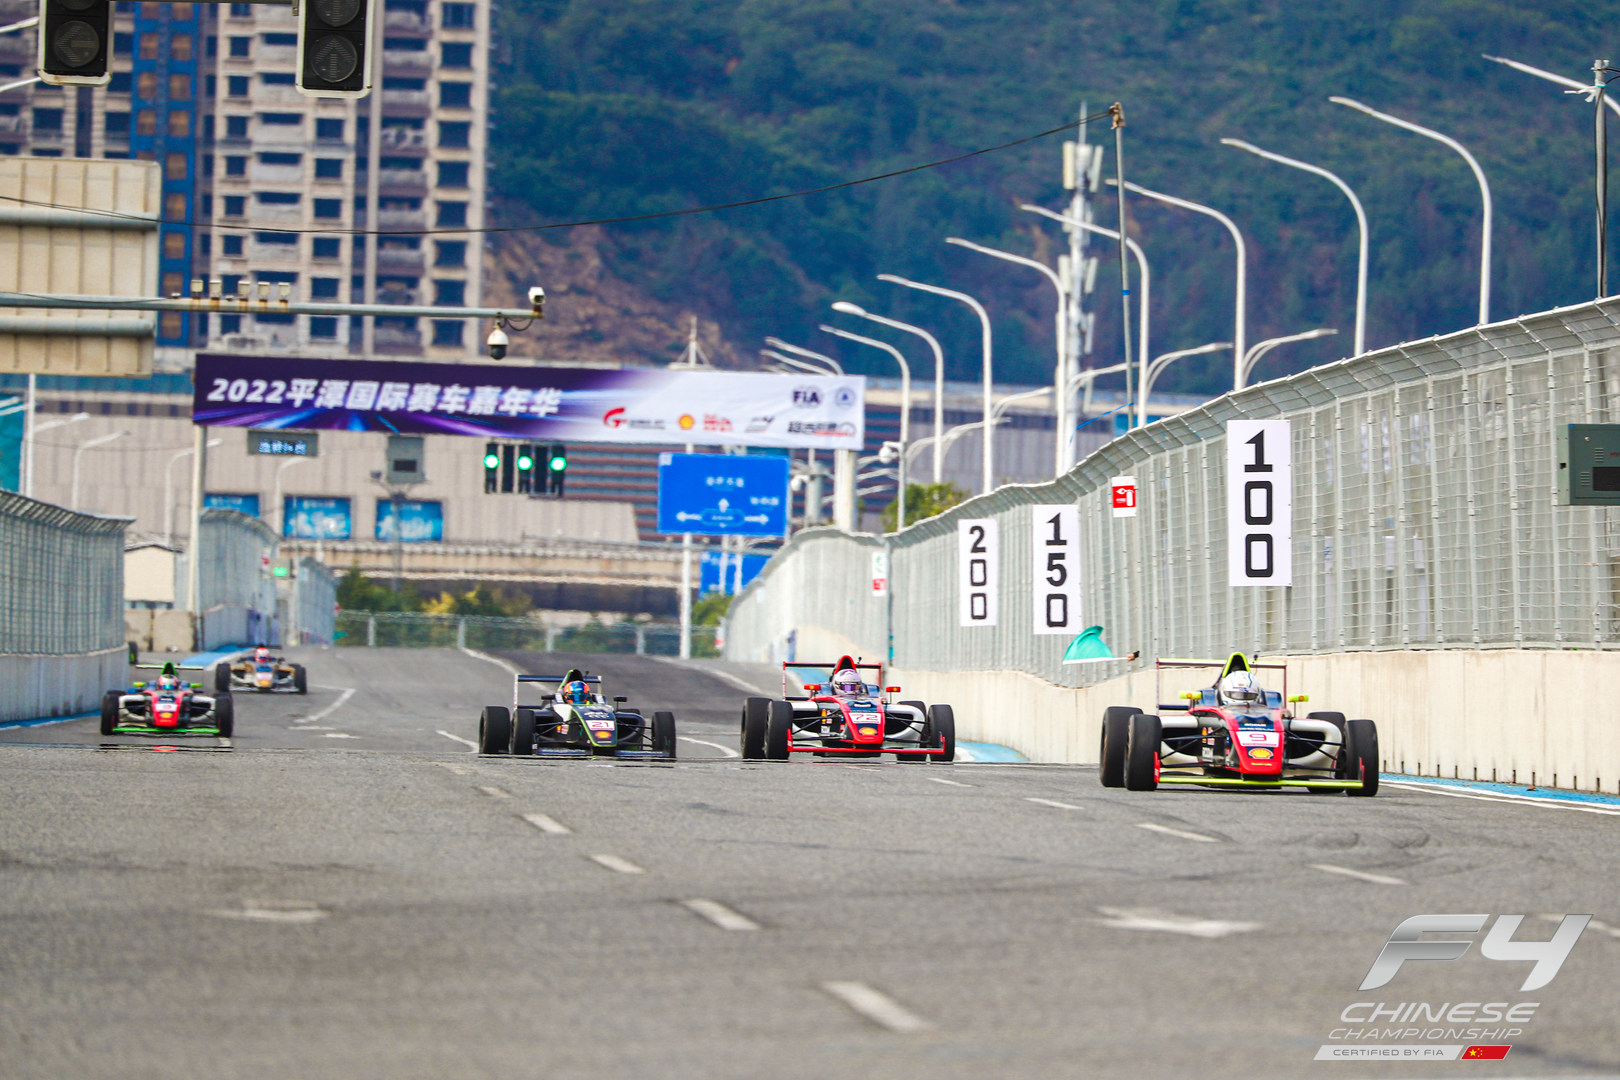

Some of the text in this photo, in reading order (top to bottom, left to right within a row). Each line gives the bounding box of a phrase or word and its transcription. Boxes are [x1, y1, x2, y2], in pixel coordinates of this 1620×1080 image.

[206, 377, 563, 417] 2022平潭国际赛车嘉年华
[793, 391, 820, 404] FIA
[1244, 428, 1274, 578] 100
[968, 524, 988, 621] 200
[1045, 511, 1068, 628] 150
[851, 713, 879, 721] 72
[1249, 733, 1267, 742] 9
